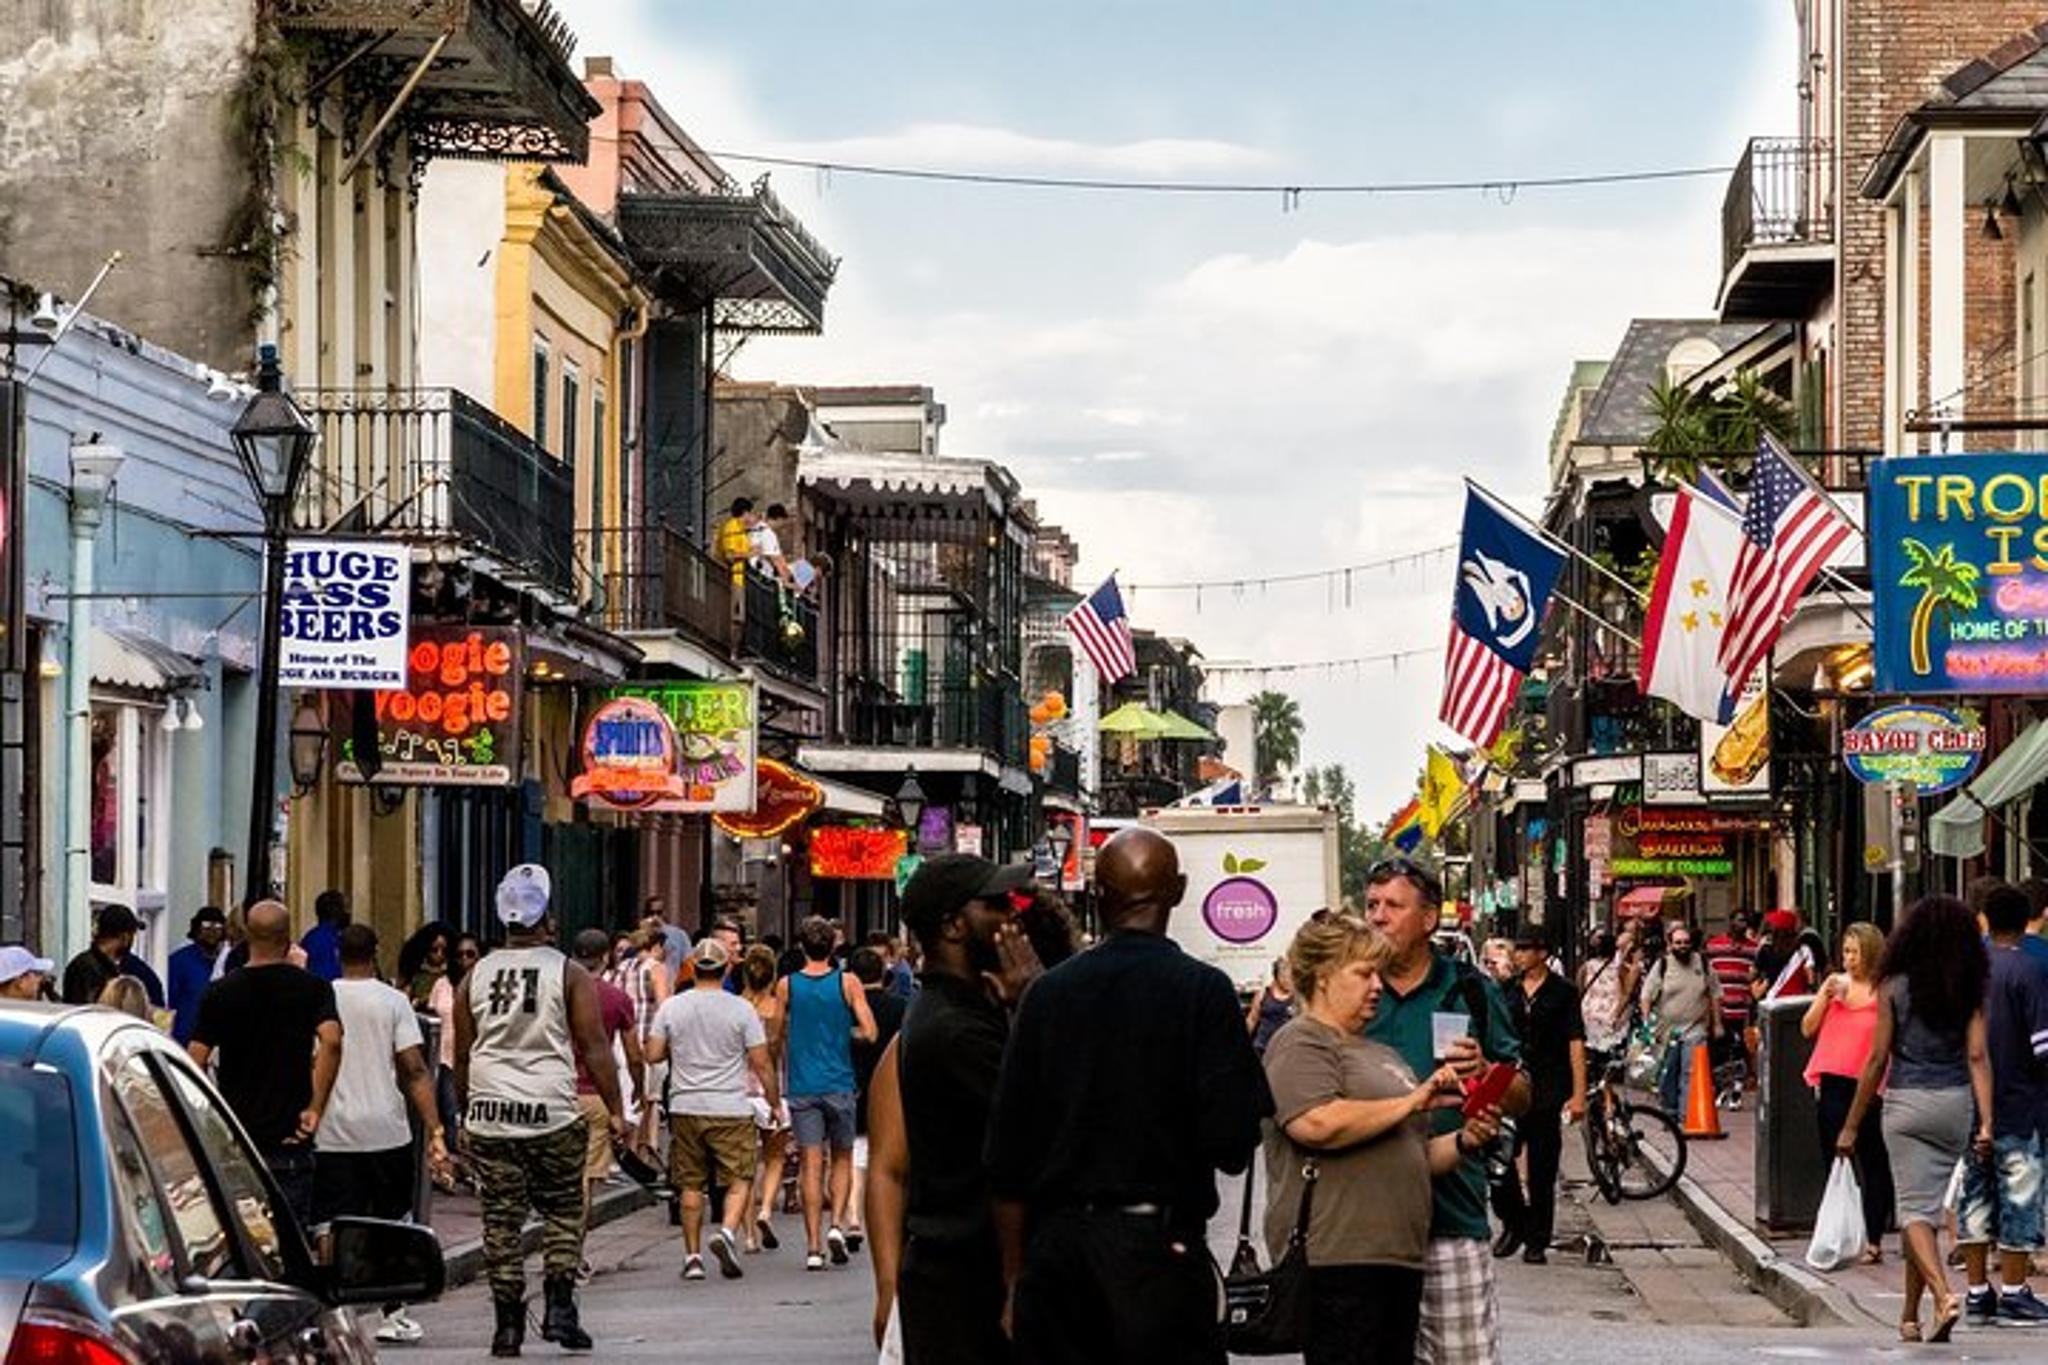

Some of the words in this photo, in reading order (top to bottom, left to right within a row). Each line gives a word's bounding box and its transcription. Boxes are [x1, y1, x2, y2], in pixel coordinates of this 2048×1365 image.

[1895, 473, 2048, 522] TRO
[285, 551, 399, 580] HUGE
[282, 581, 390, 608] ASS
[1950, 621, 2001, 640] HOME
[2004, 619, 2029, 639] OF
[289, 653, 329, 664] Home
[332, 653, 348, 665] of
[352, 655, 377, 666] The
[310, 669, 336, 680] ASS
[340, 670, 401, 683] BURGER
[1843, 730, 1918, 752] BAYOU
[1928, 727, 1987, 752] CLUB
[1216, 901, 1265, 920] fresh
[489, 969, 541, 1015] #1
